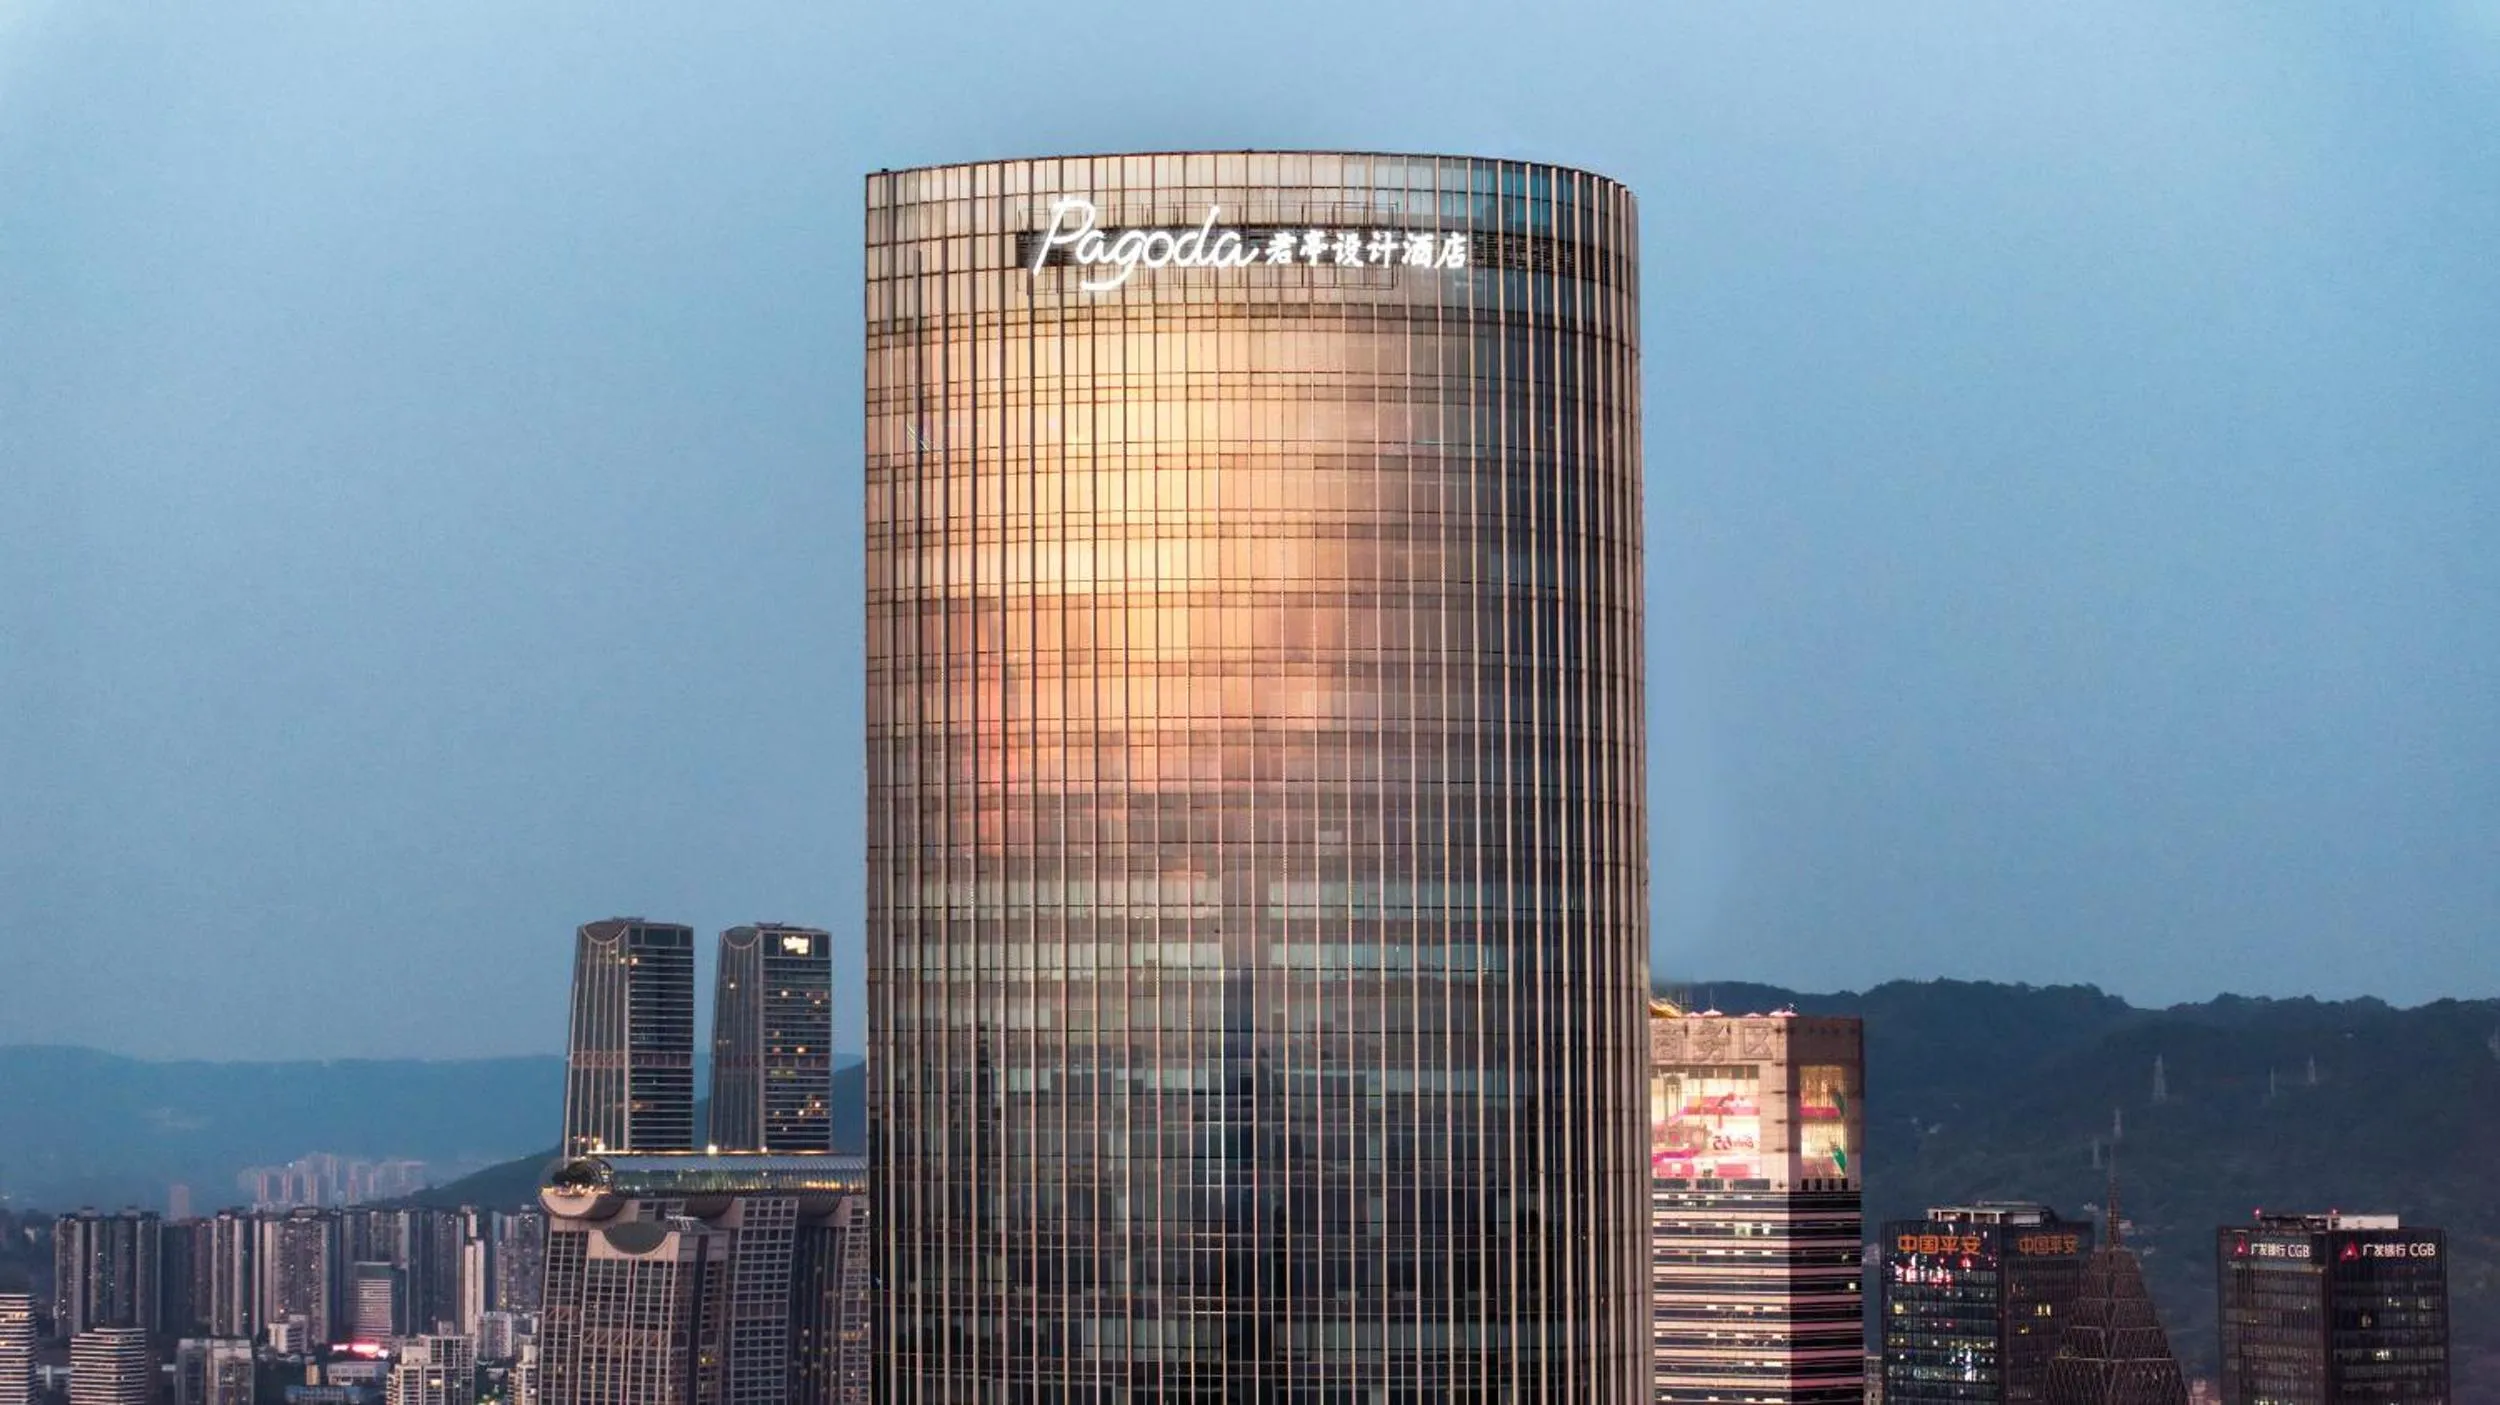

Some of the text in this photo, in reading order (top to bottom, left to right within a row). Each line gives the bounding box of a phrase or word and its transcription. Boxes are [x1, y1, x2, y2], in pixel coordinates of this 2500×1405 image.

[1033, 198, 1259, 292] Pagoda
[1266, 229, 1467, 268] 君亭设计酒店
[1898, 1234, 1981, 1255] 中国平安
[2019, 1235, 2079, 1255] 中国平安
[2251, 1243, 2310, 1257] 广发银行 CGB
[2363, 1243, 2436, 1257] 广发银行 CGB
